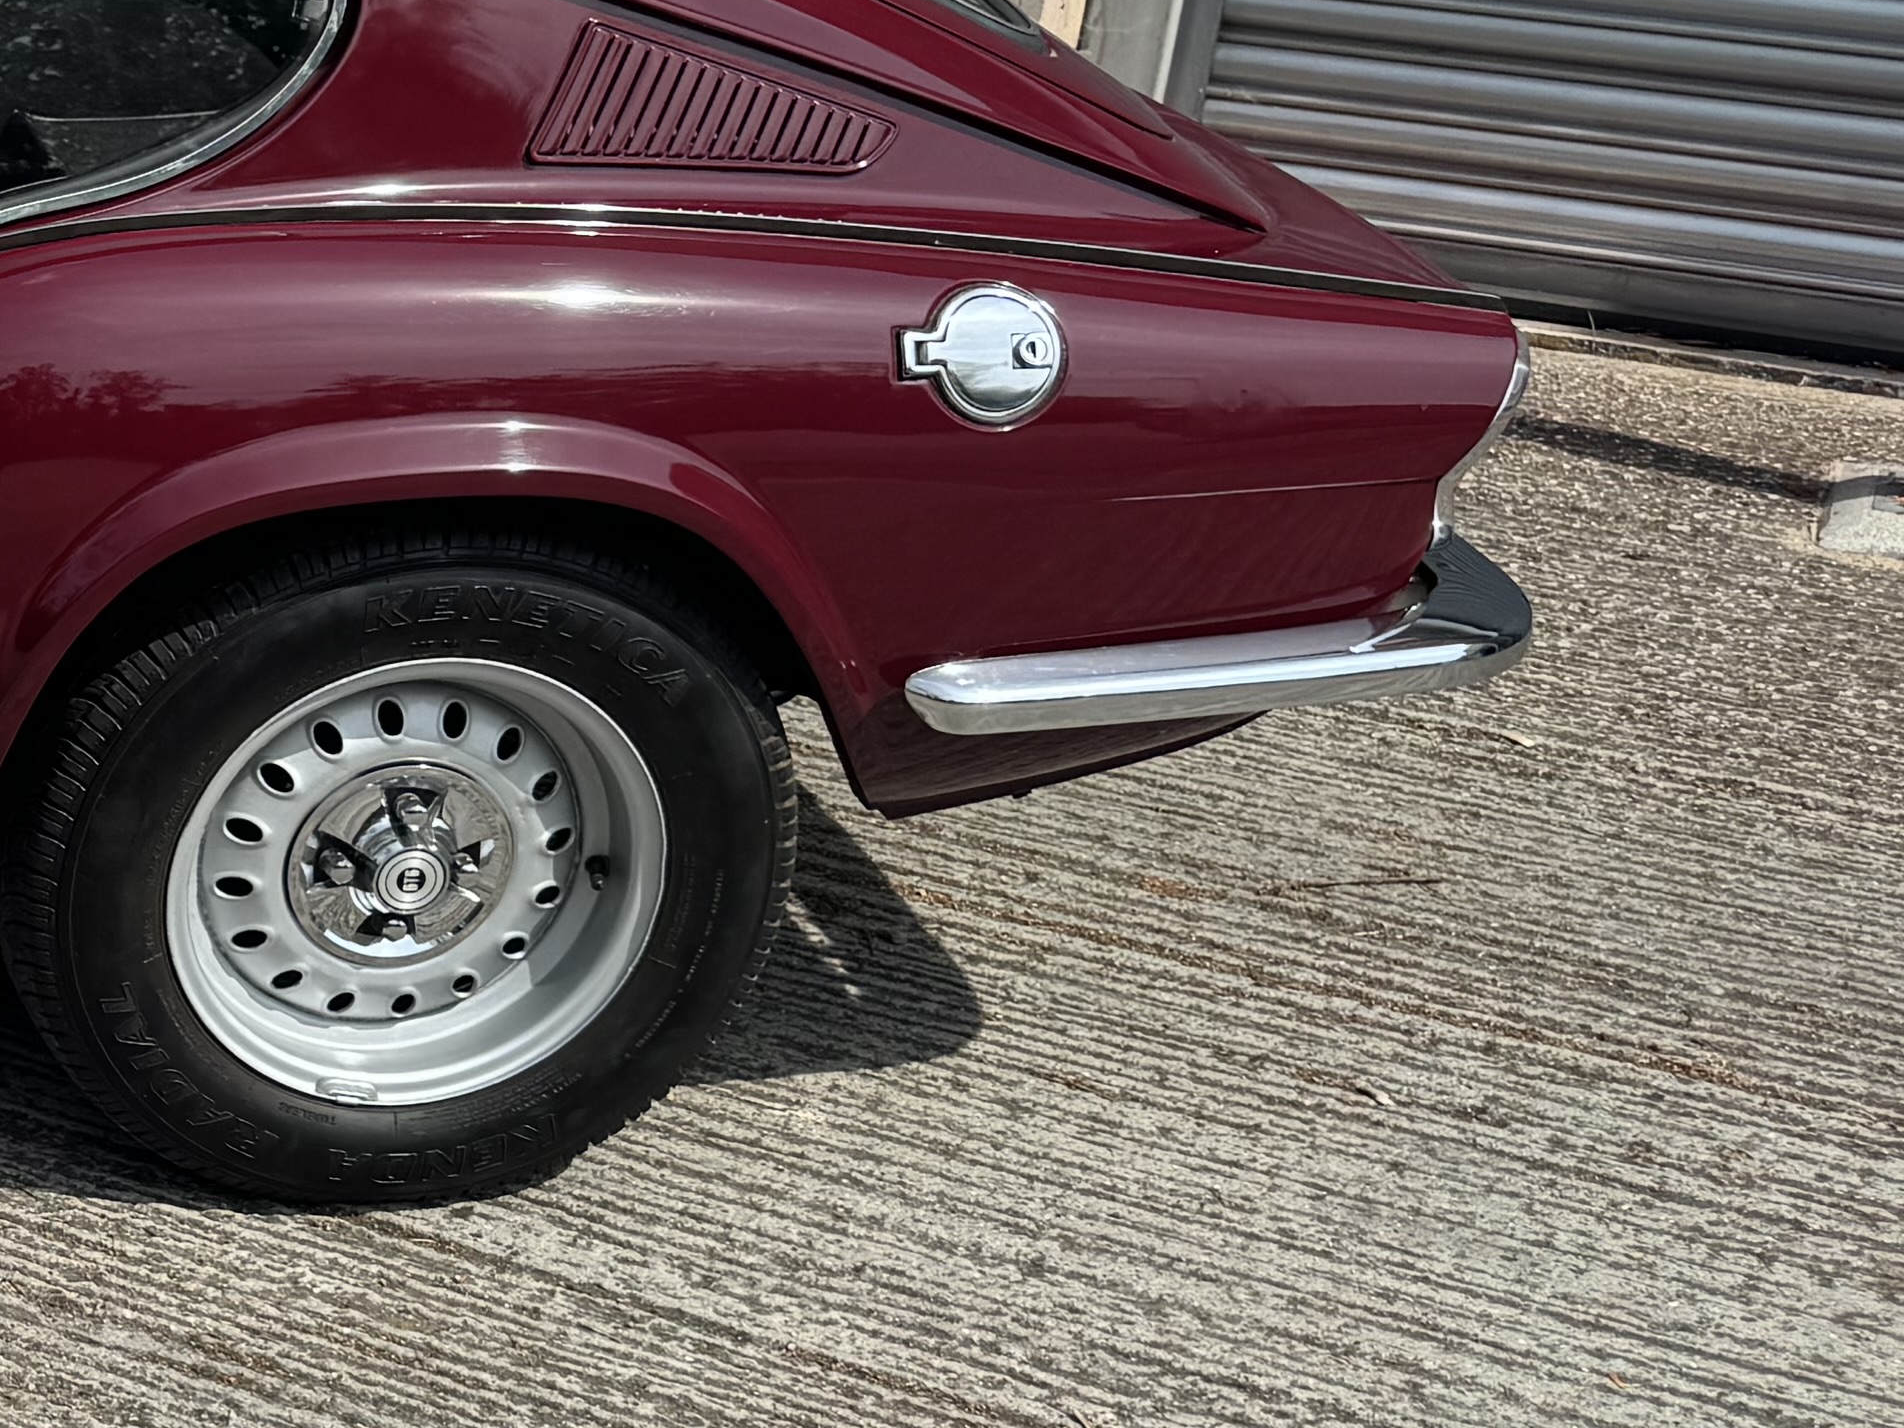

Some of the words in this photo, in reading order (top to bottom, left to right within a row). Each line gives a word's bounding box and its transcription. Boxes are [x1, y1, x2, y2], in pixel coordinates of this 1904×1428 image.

[364, 586, 691, 708] KENETICA
[99, 981, 277, 1159] RADIAL
[329, 1114, 559, 1184] KENDA
